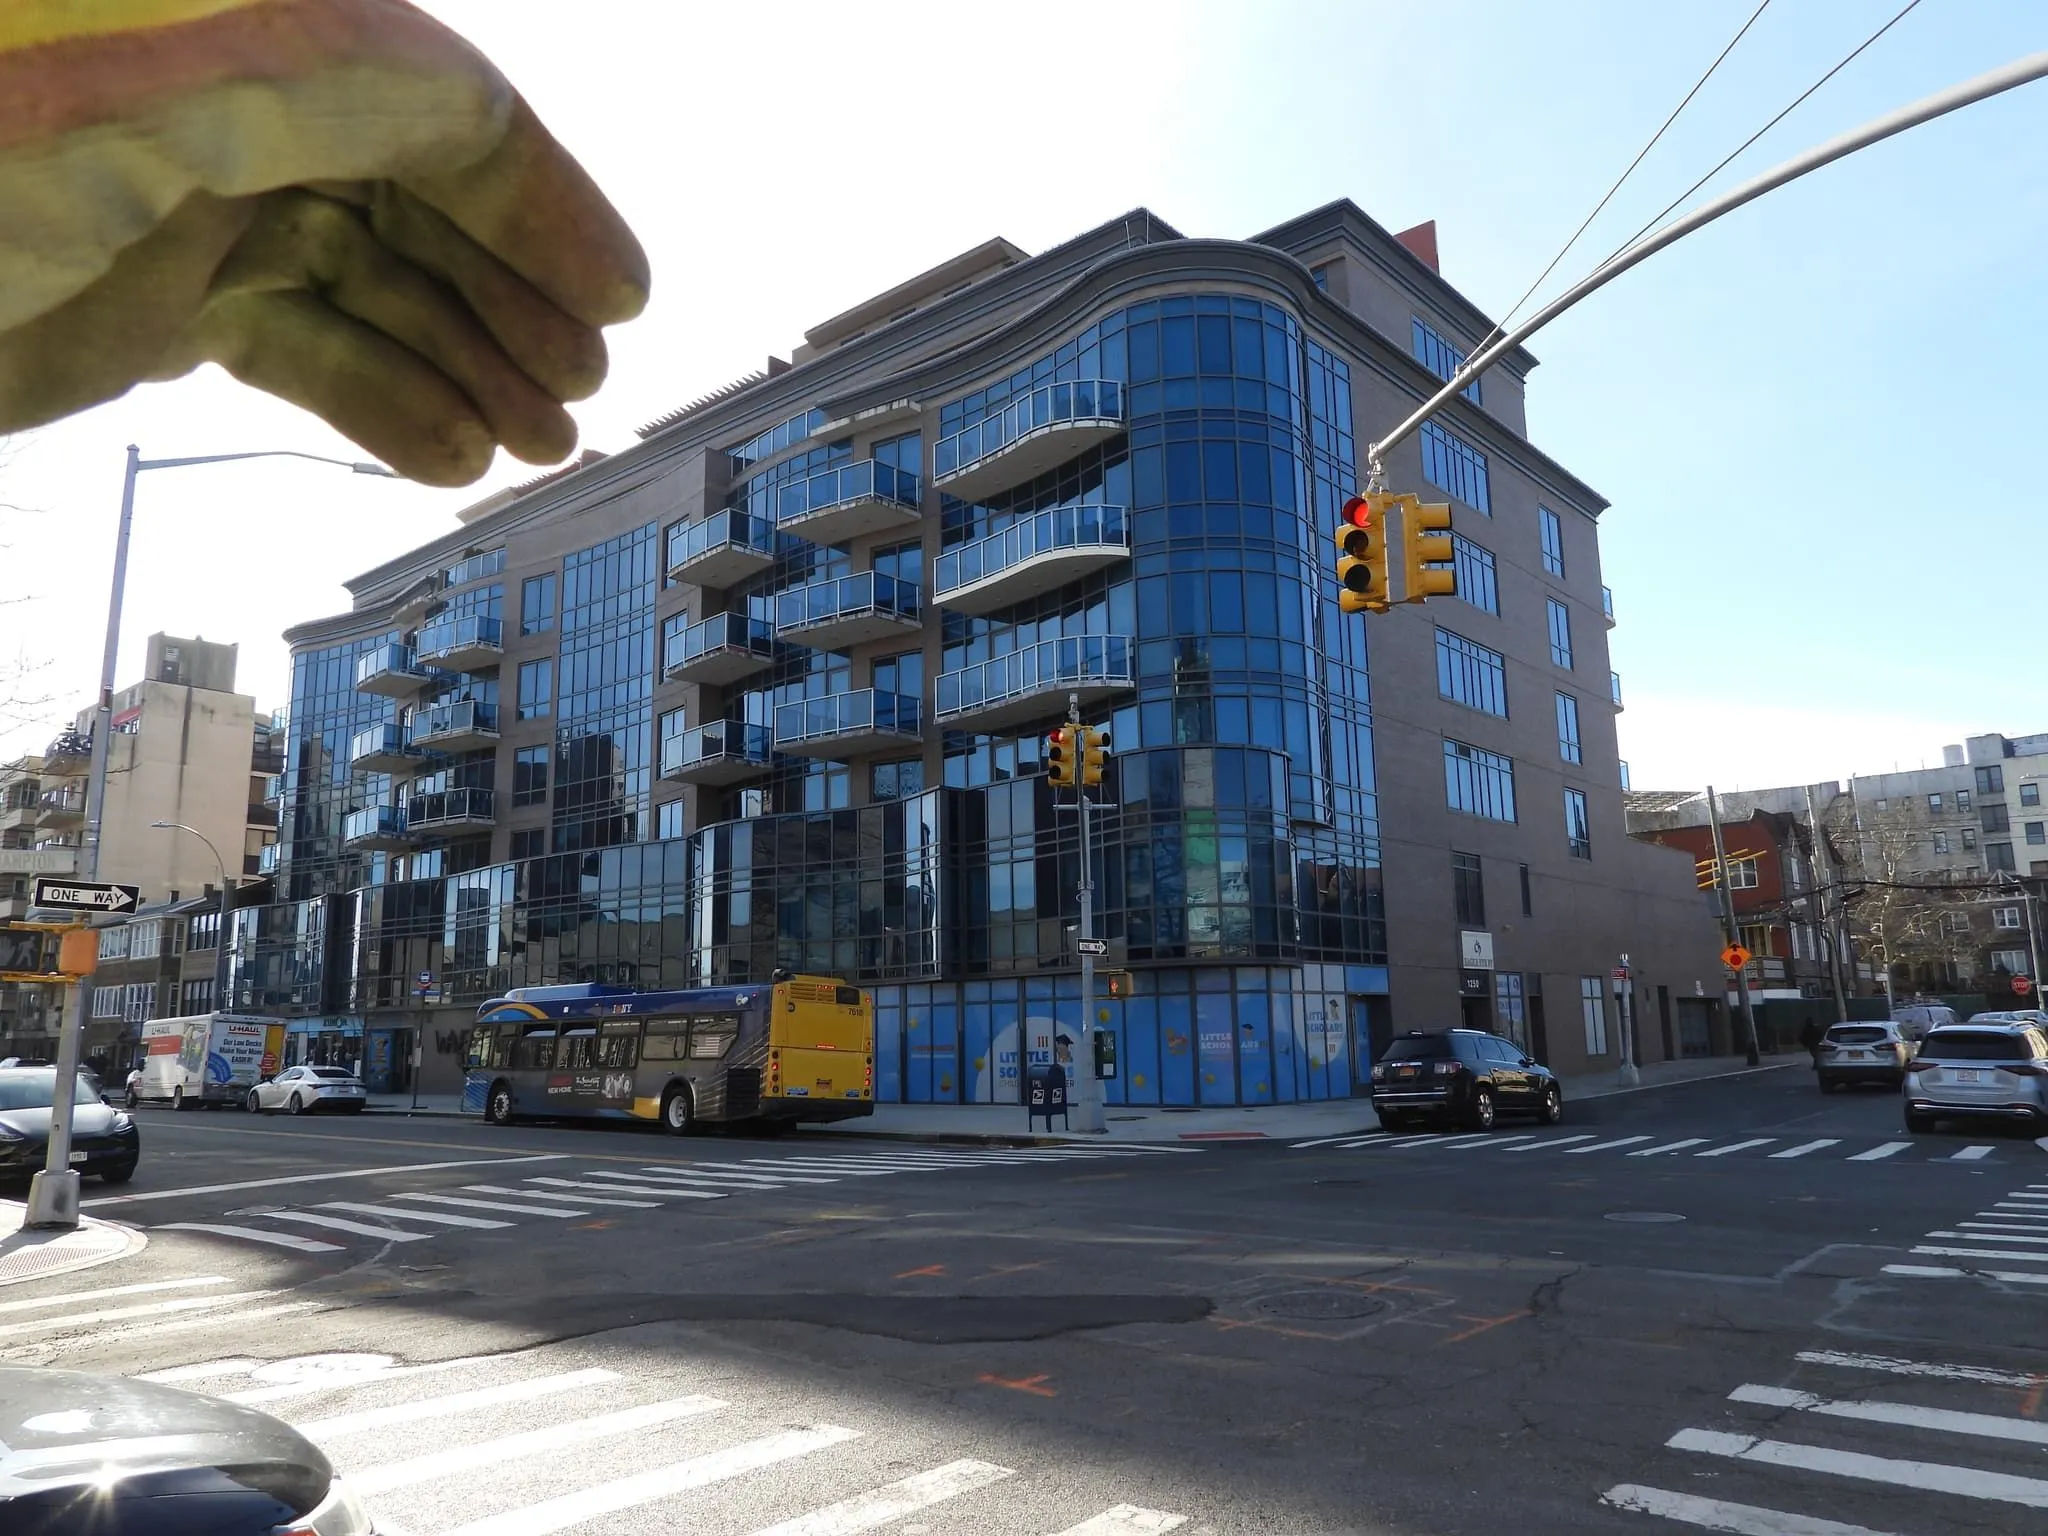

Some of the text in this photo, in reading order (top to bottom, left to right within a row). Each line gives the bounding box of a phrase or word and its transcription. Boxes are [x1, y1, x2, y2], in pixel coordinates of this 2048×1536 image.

[51, 889, 123, 905] ONE WAY
[2013, 981, 2028, 989] STOP
[229, 1025, 260, 1033] U-HAUL
[1200, 1032, 1232, 1041] LITTLE
[1000, 1051, 1049, 1063] LITTLE
